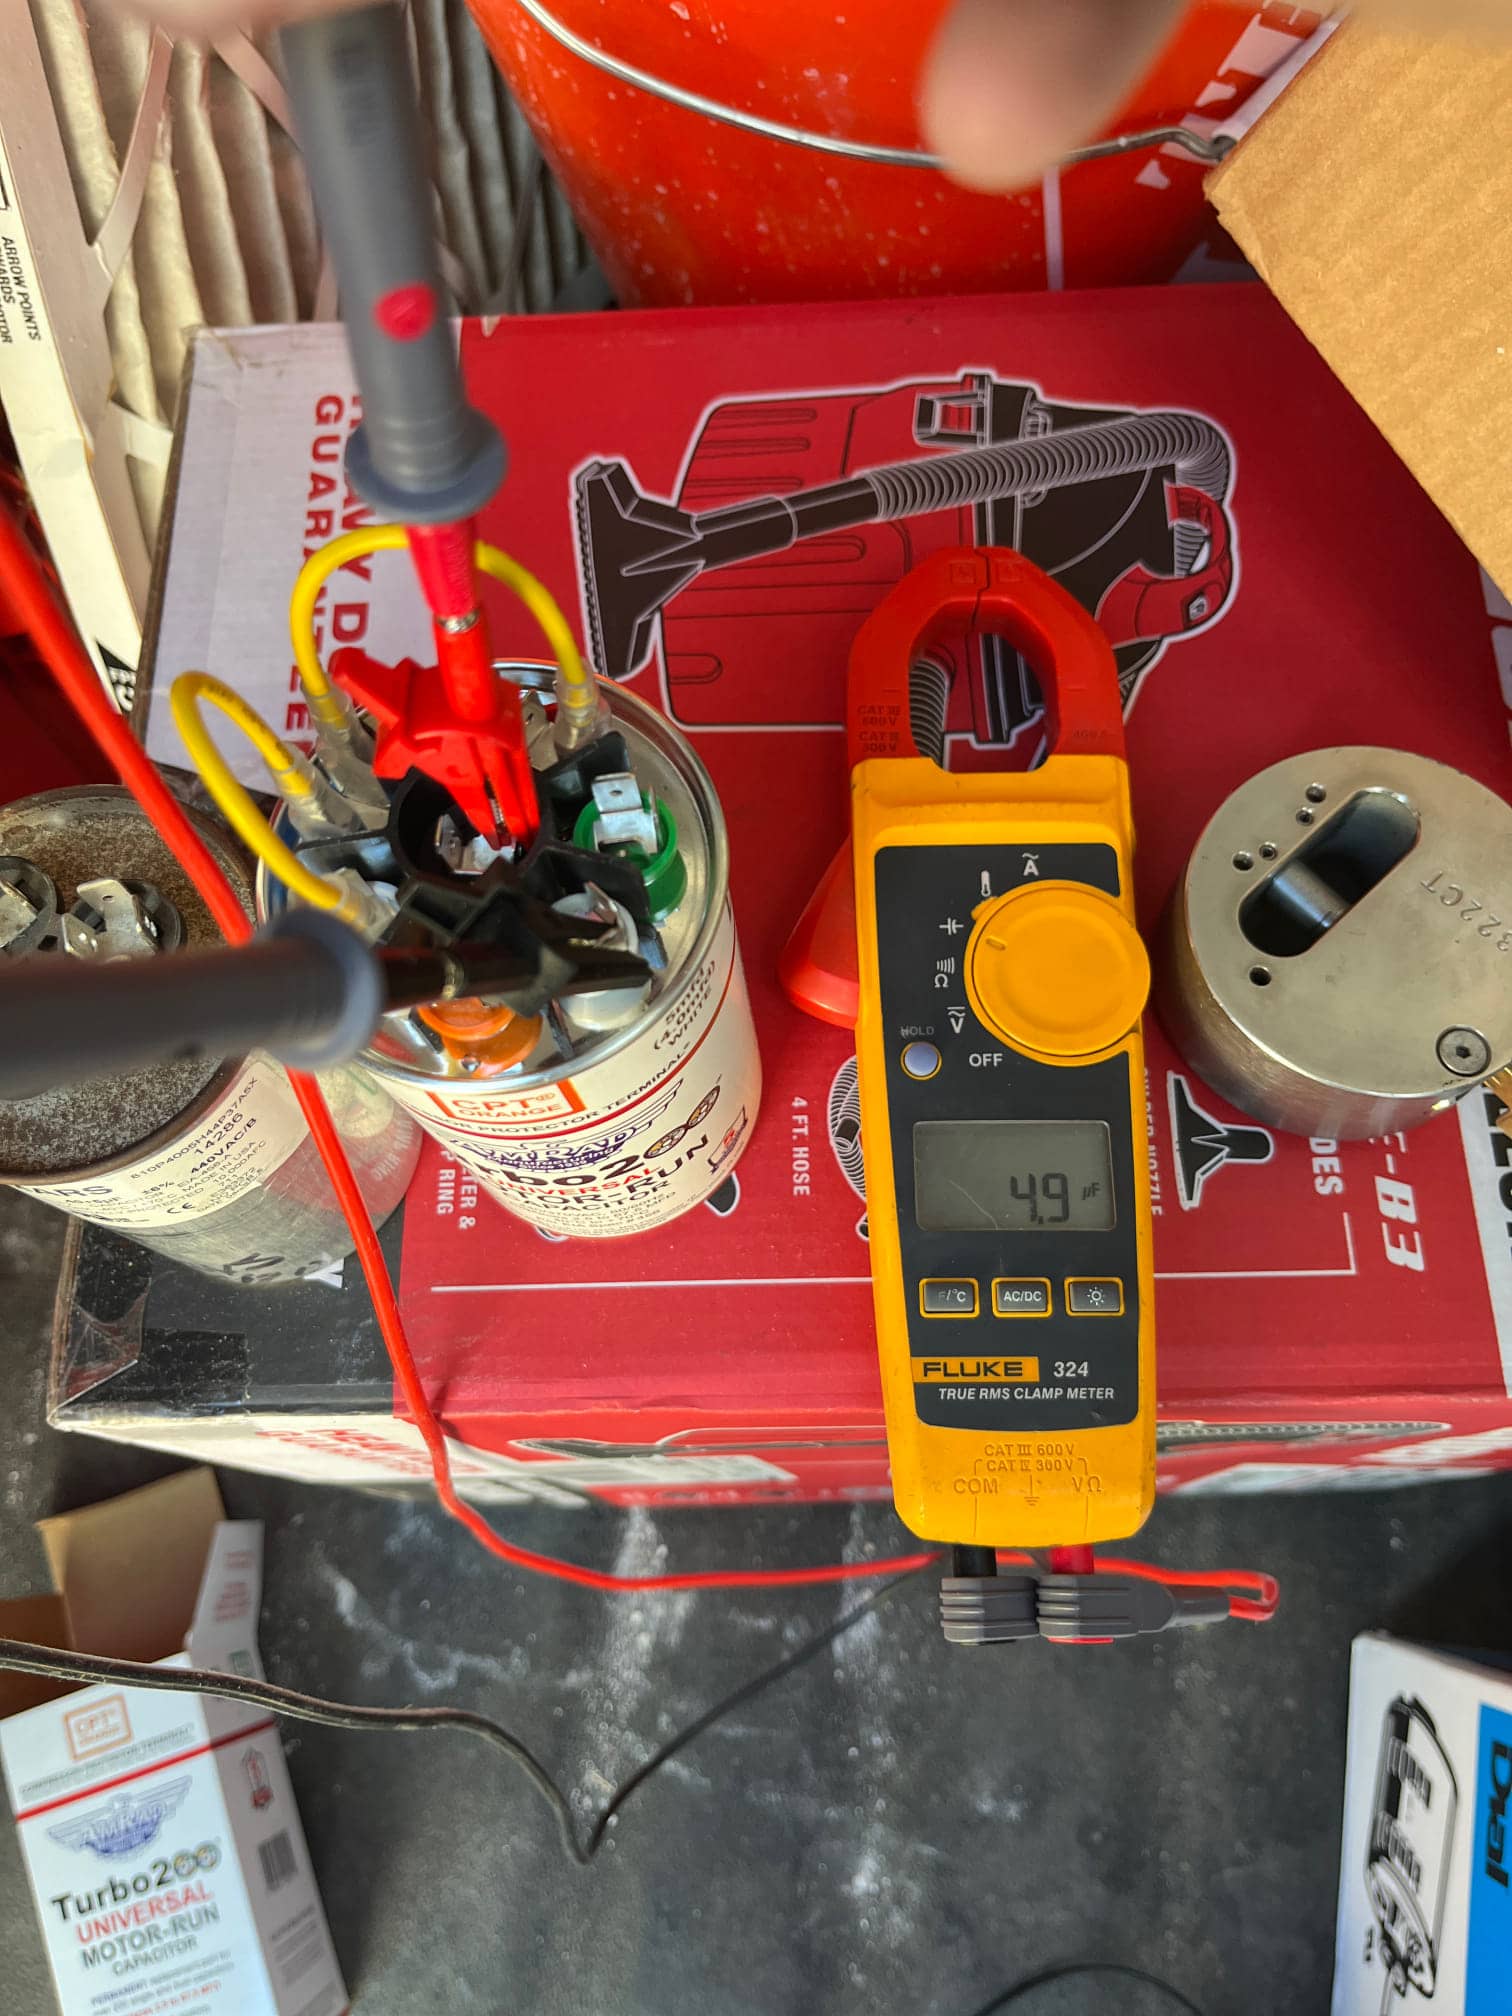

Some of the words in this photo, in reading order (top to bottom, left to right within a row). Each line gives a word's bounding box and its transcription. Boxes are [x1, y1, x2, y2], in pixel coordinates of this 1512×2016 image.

[2, 236, 27, 288] ARROW
[17, 291, 41, 340] POINTS
[968, 1053, 1004, 1067] OFF
[791, 1096, 808, 1108] 4
[459, 1104, 562, 1118] ORANGE
[479, 1110, 599, 1133] PROTECTOR
[791, 1114, 809, 1140] FT.
[791, 1146, 811, 1197] HOSE
[436, 1168, 456, 1215] RING
[1003, 1290, 1042, 1302] AC/DC
[923, 1361, 1023, 1377] FLUKE
[1053, 1361, 1089, 1377] 324
[938, 1387, 975, 1400] TRUE
[979, 1387, 1010, 1400] RMS
[1016, 1387, 1063, 1400] CLAMP
[1066, 1387, 1114, 1400] METER
[984, 1444, 1015, 1456] CAT
[986, 1460, 1014, 1472] CAT
[953, 1478, 998, 1494] COM
[76, 1880, 212, 1944] UNIVERSAL
[82, 1903, 220, 1969] MOTOR-RUN
[112, 1936, 198, 1976] CAPACITOR
